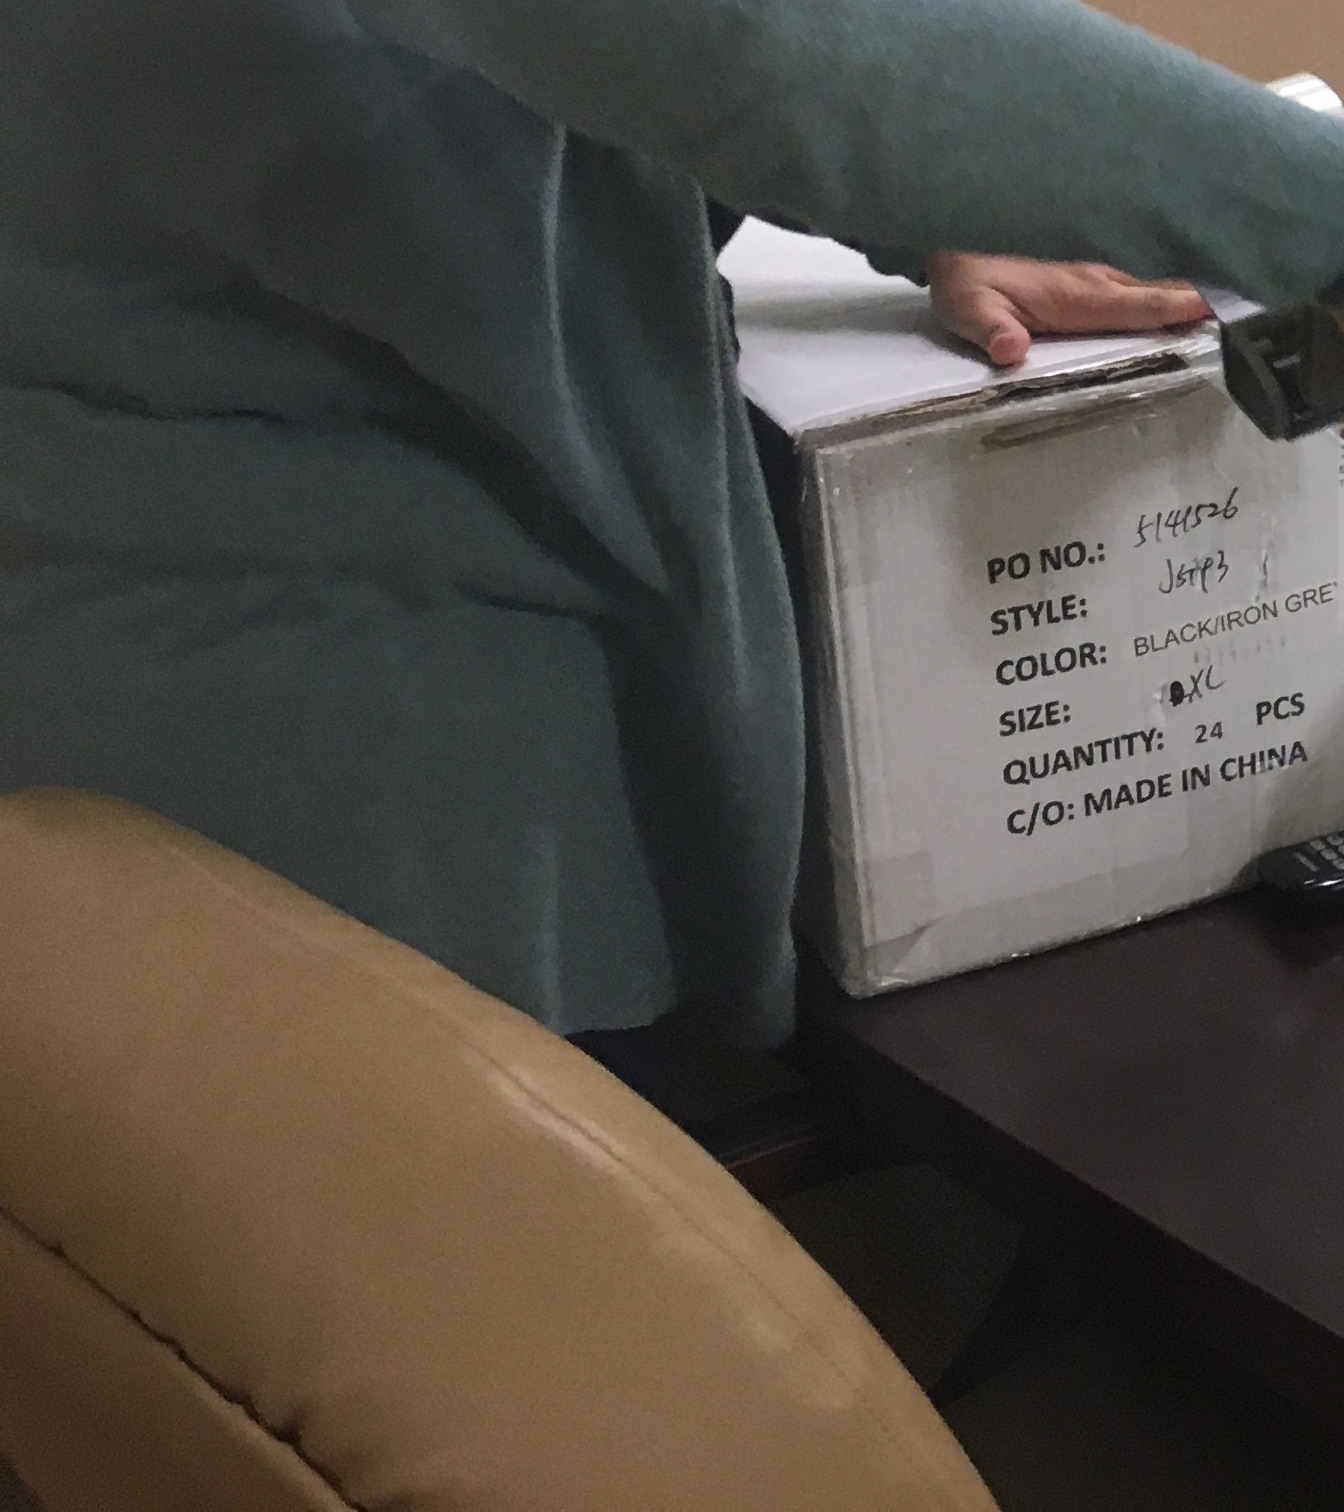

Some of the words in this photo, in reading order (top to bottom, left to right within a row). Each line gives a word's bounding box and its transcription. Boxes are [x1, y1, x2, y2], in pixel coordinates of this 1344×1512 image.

[986, 552, 1030, 584] PO
[1039, 541, 1106, 574] NO.:
[990, 594, 1088, 636] STYLE:
[996, 642, 1107, 686] COLOR:
[1133, 601, 1279, 657] BLACK/IRON
[1284, 582, 1338, 614] GRE
[999, 700, 1072, 737] SIZE:
[1002, 727, 1164, 786] QUANTITY:
[1194, 721, 1224, 744] 24
[1255, 692, 1306, 726] PCS
[1006, 800, 1075, 836] C/O:
[1084, 773, 1173, 817] MADE
[1181, 763, 1211, 793] IN
[1219, 741, 1309, 782] CHINA
